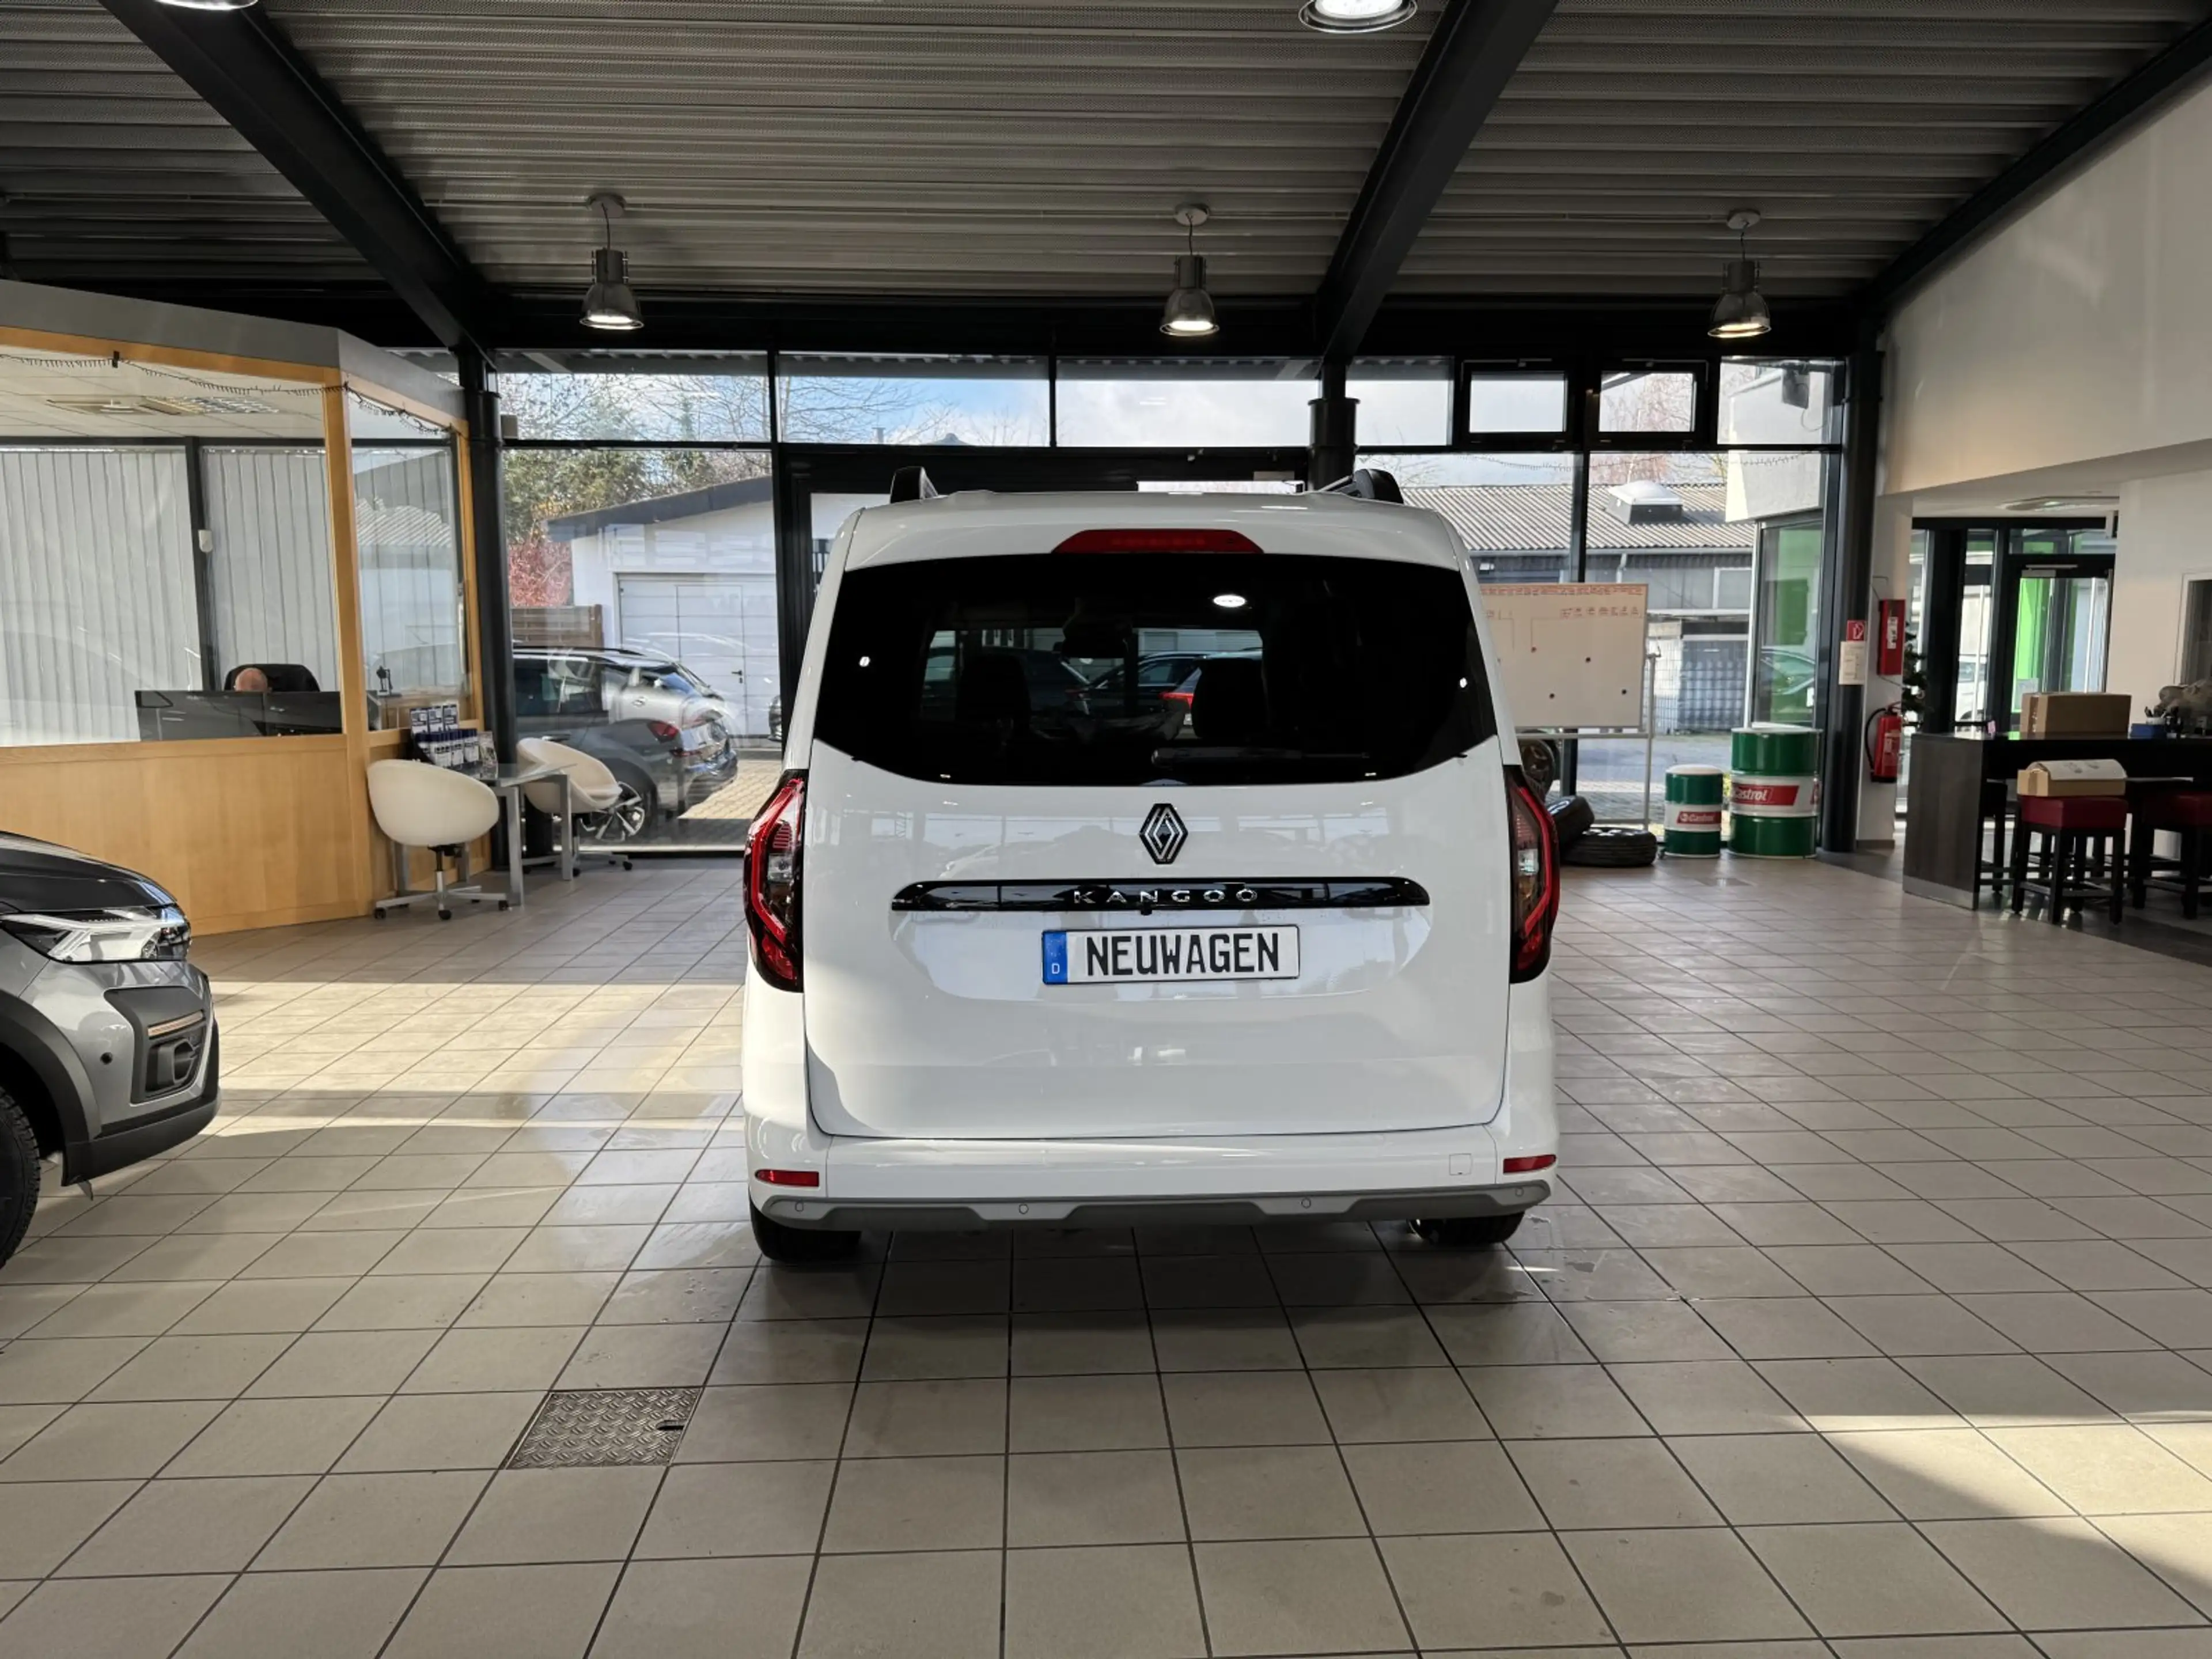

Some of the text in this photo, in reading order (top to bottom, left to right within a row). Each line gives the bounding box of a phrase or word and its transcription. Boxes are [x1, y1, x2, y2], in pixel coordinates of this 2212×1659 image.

[1733, 787, 1768, 801] Castrol
[1074, 889, 1257, 904] KANGOO
[1086, 932, 1279, 976] NEUWAGEN
[1051, 963, 1060, 974] D
